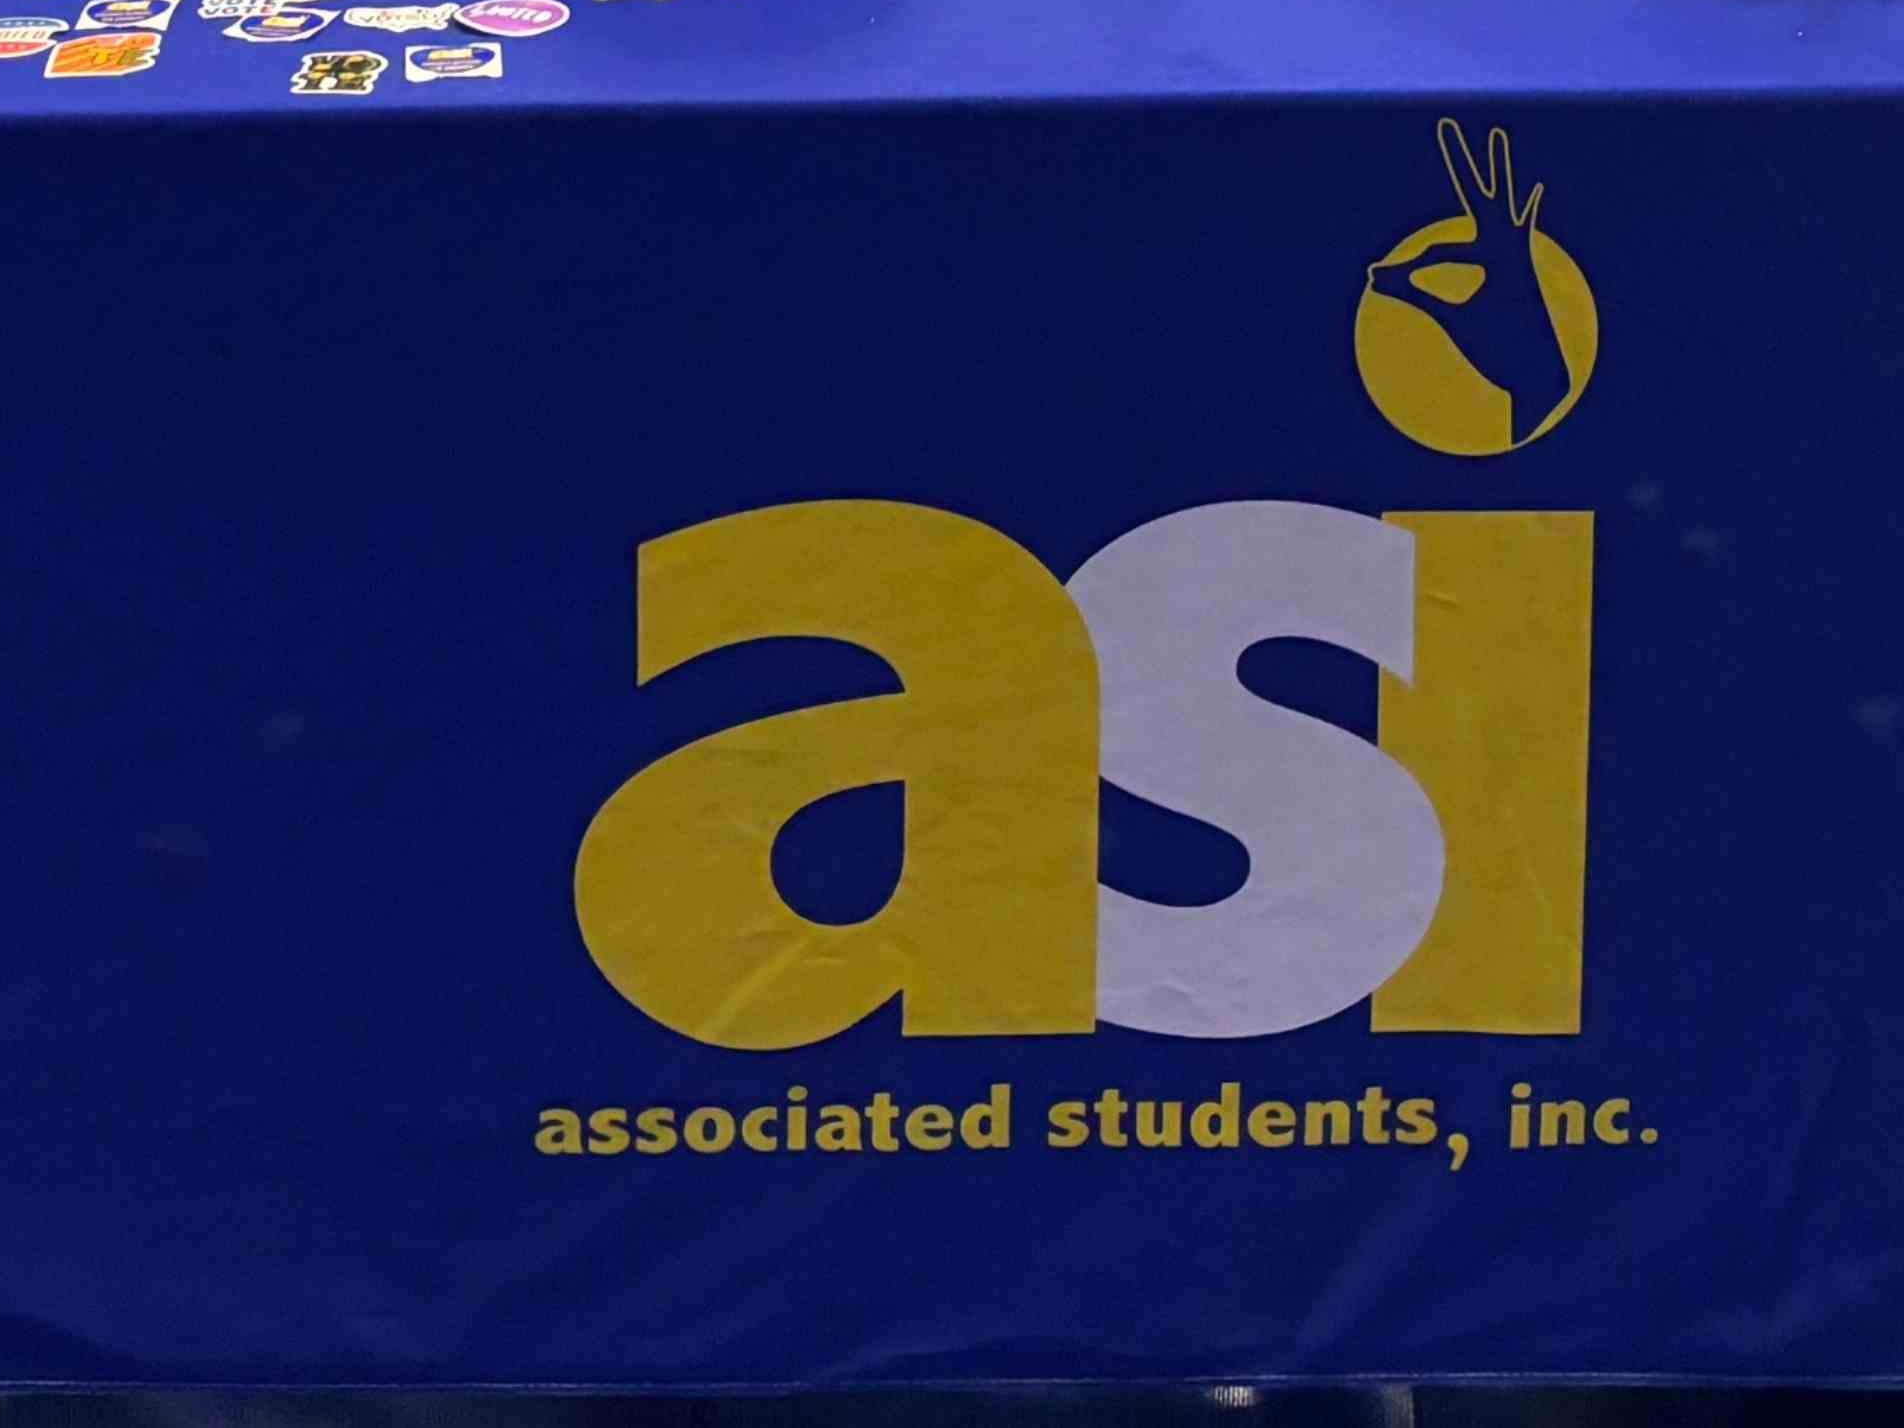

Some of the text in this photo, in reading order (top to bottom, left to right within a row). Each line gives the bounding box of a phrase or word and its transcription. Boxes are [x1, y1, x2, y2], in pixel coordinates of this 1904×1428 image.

[203, 6, 273, 15] VOTE
[573, 498, 1596, 1052] asi
[535, 1081, 1660, 1170] associated students, inc.
